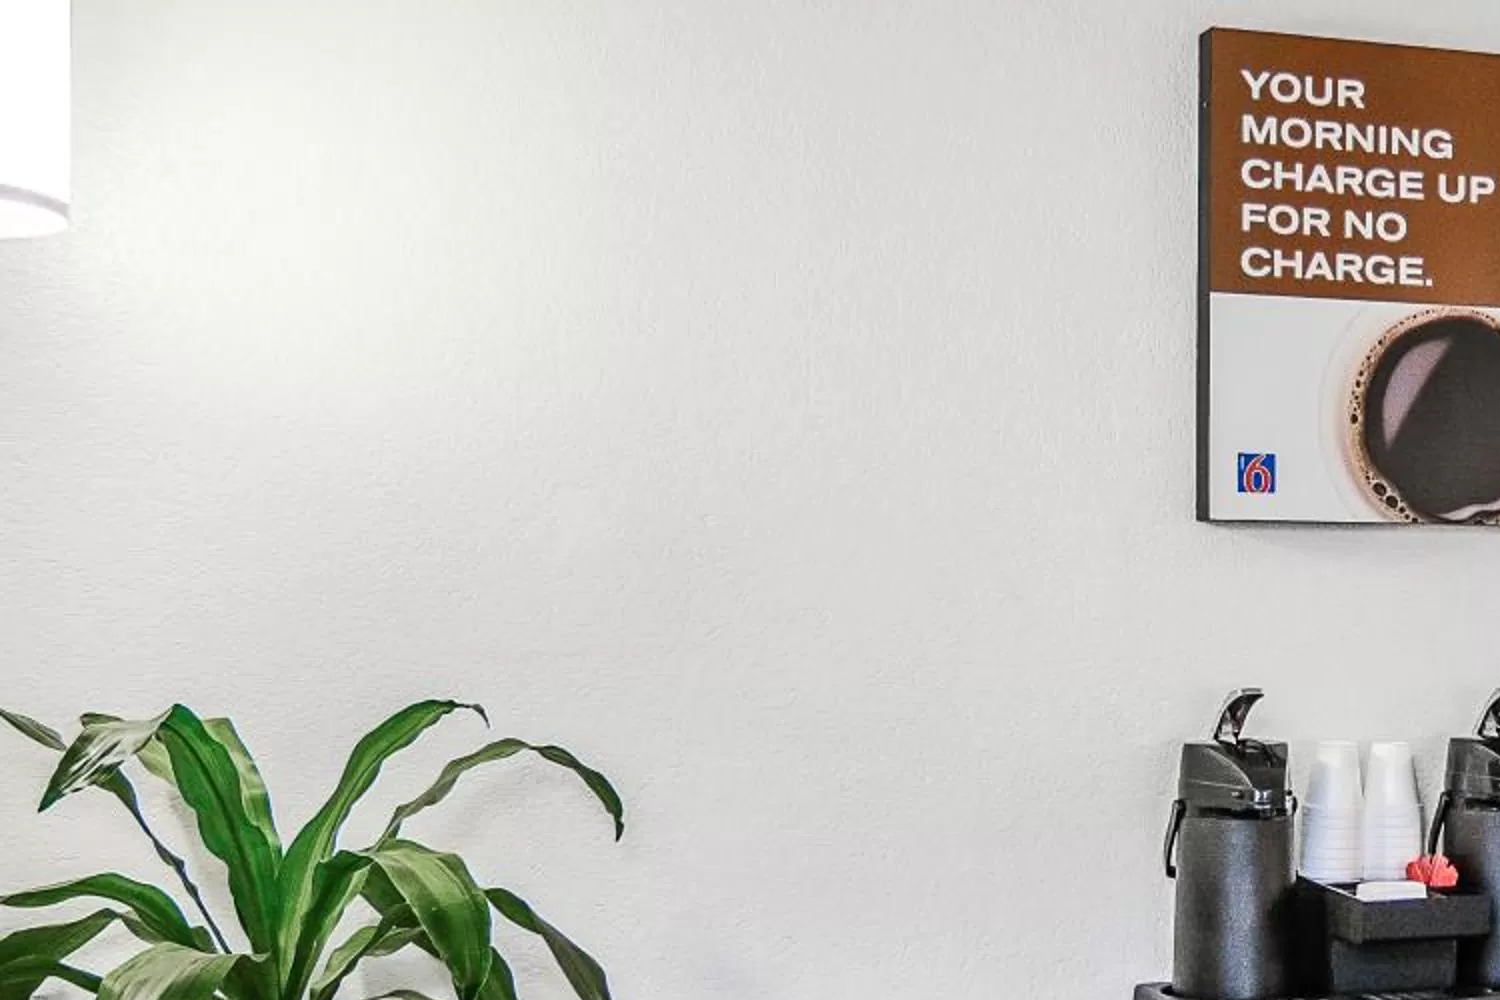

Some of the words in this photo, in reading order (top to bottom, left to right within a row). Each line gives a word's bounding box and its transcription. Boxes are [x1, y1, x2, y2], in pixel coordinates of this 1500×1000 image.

[1241, 69, 1365, 109] YOUR
[1241, 114, 1453, 160] MORNING
[1241, 159, 1425, 200] CHARGE
[1437, 172, 1496, 205] UP
[1241, 203, 1331, 238] FOR
[1343, 209, 1408, 242] NO
[1241, 247, 1433, 287] CHARGE.
